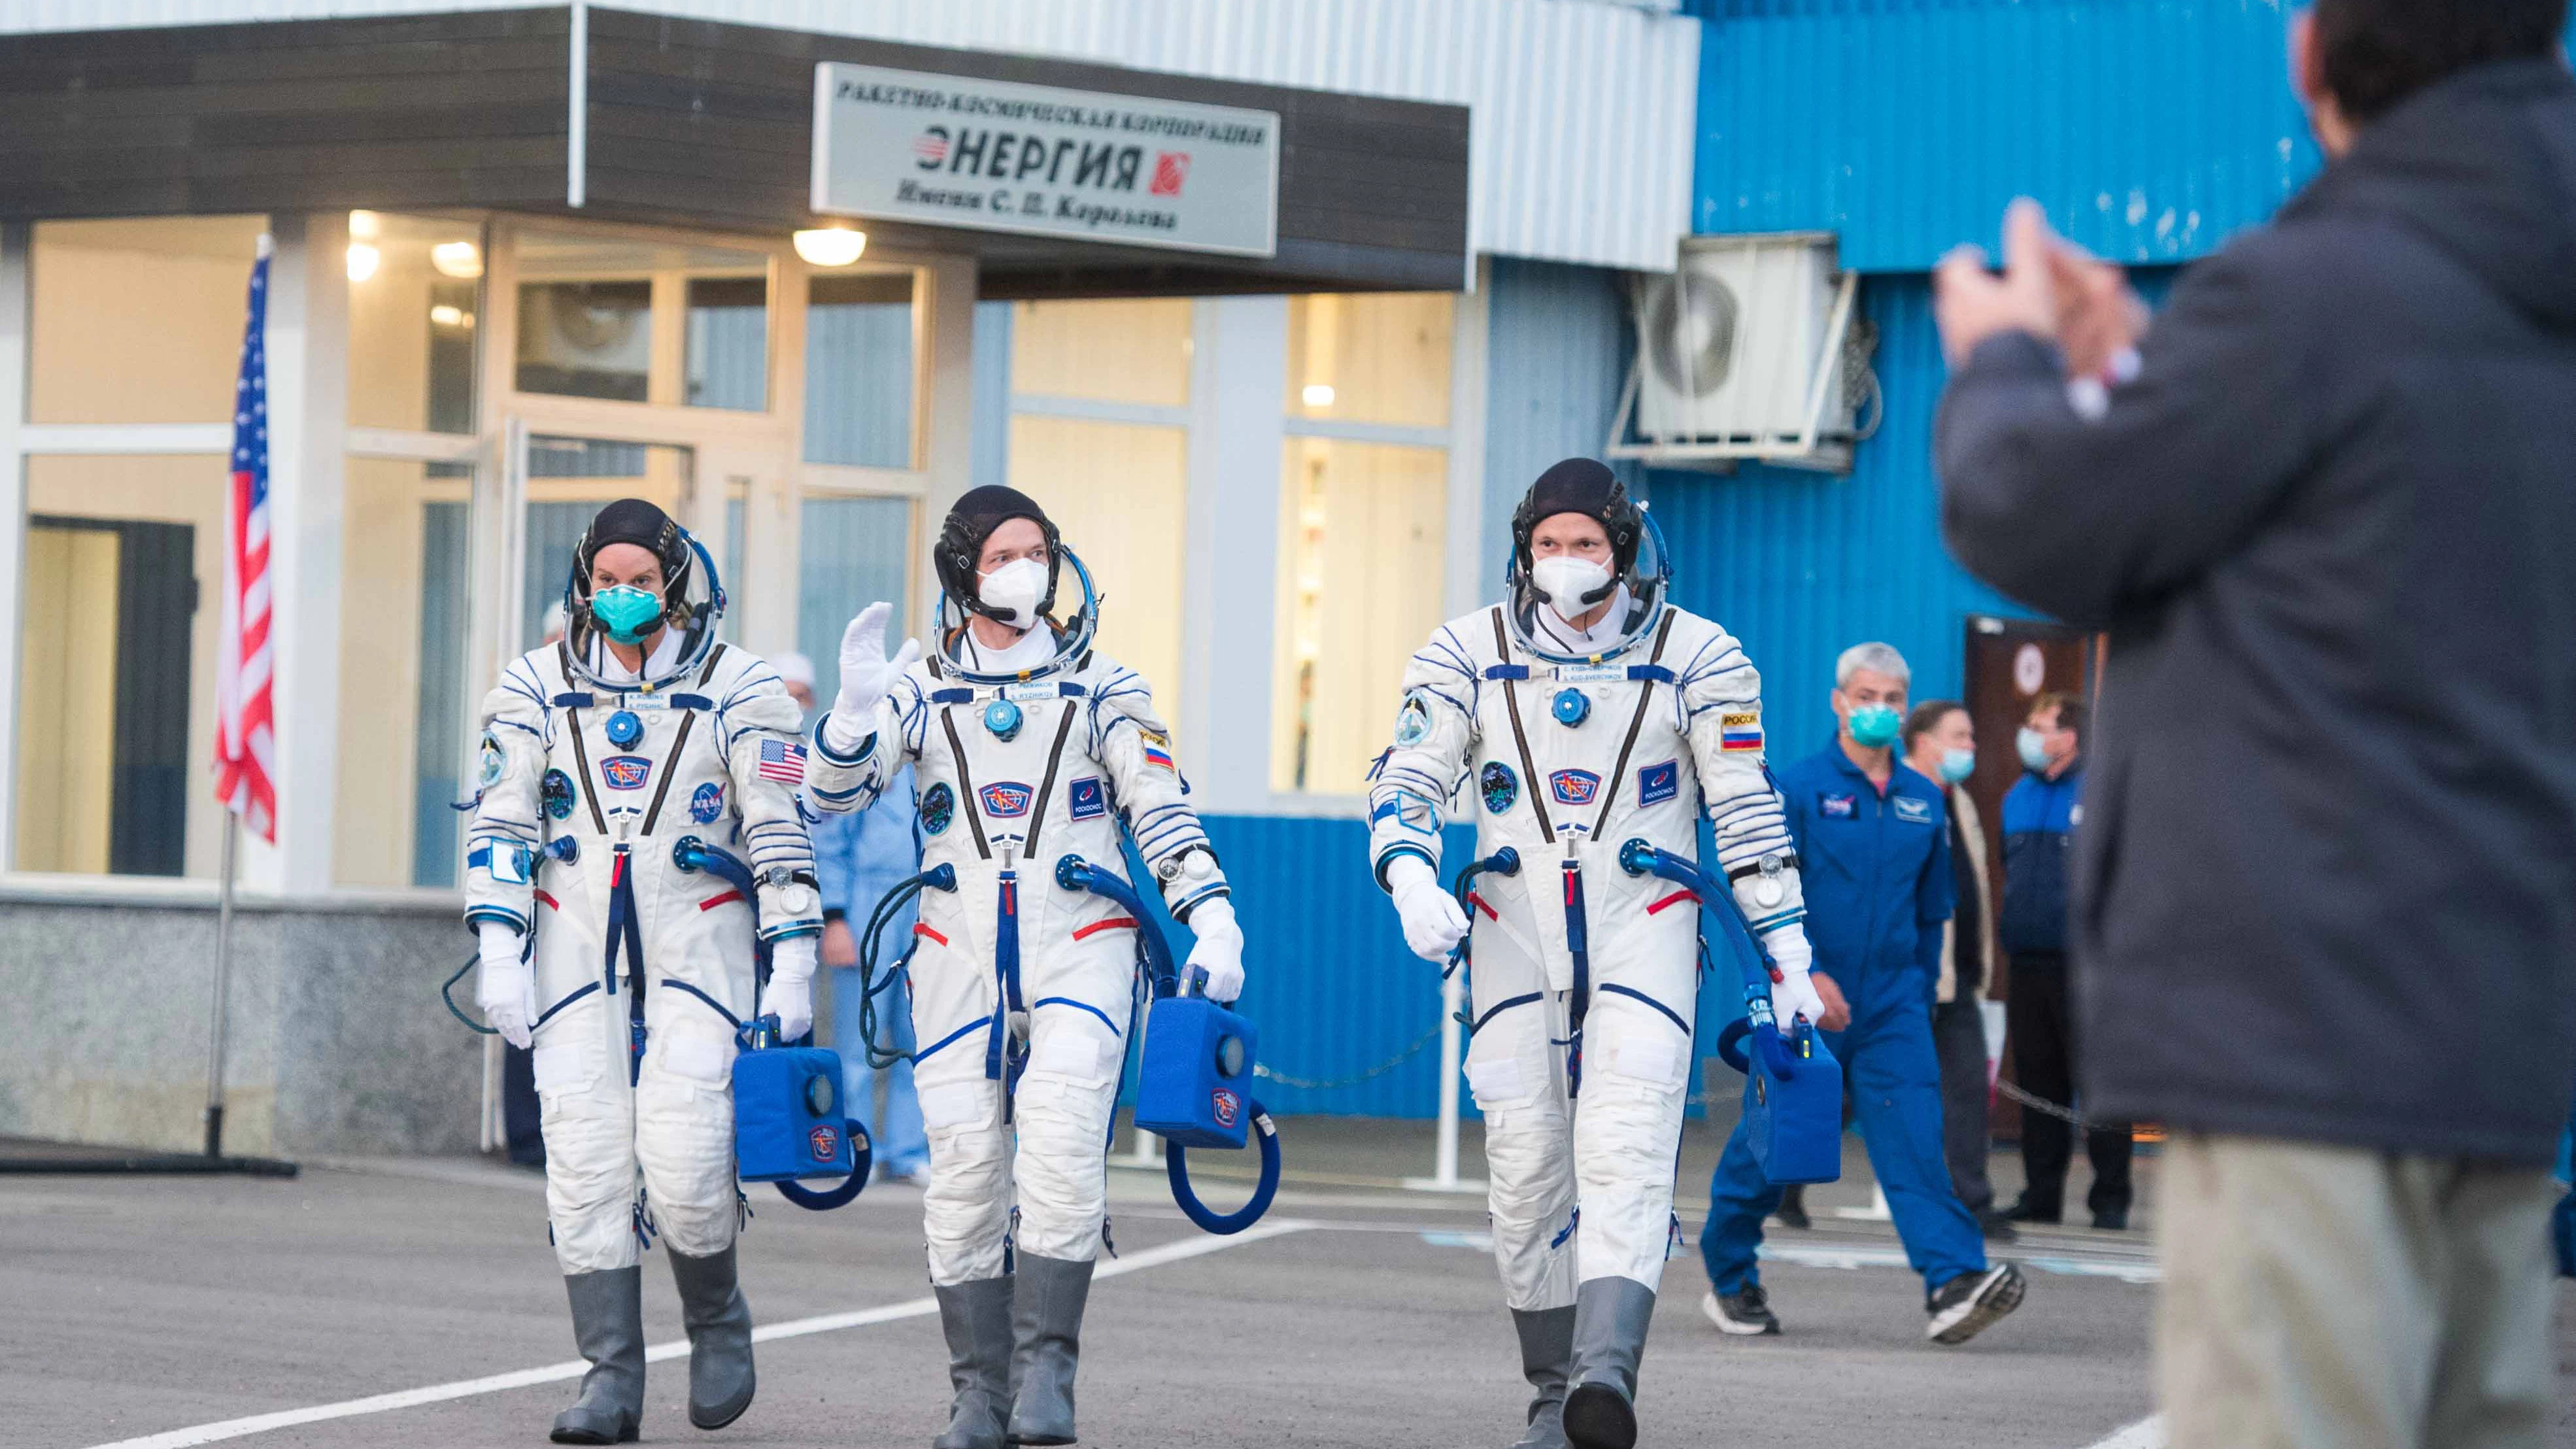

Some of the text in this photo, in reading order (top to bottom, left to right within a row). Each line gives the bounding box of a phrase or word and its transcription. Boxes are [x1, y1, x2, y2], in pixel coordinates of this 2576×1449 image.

[913, 124, 1143, 190] ЭНЕРГИЯ
[989, 189, 1013, 211] С.
[1019, 192, 1046, 214] П.
[694, 797, 720, 809] NASA
